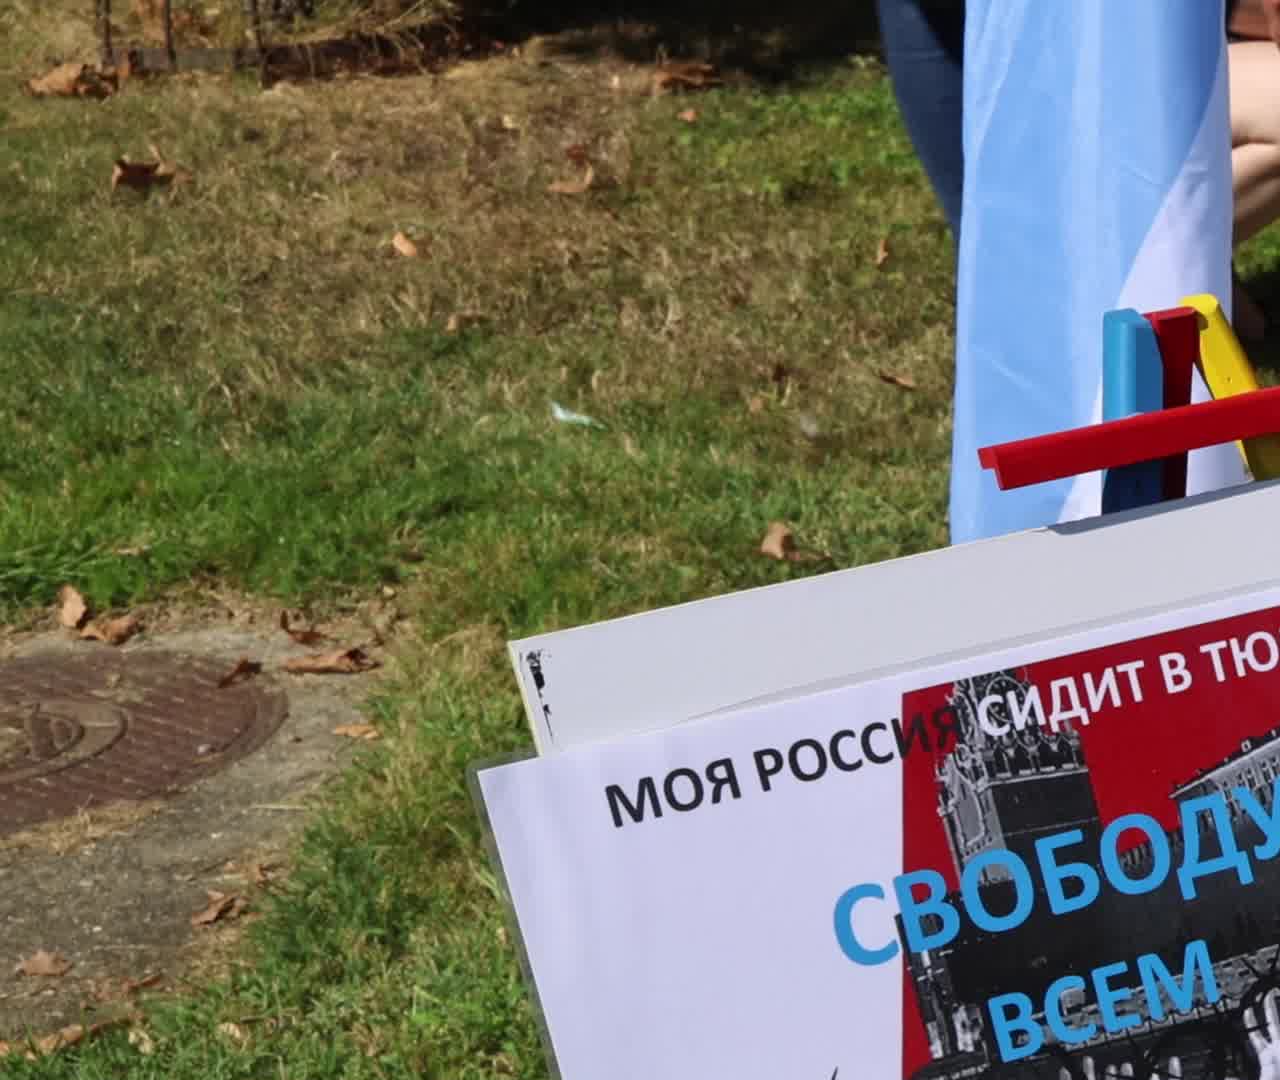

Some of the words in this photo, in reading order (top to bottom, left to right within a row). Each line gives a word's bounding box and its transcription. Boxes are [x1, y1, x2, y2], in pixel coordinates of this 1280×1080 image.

[605, 757, 741, 828] МОЯ
[753, 707, 963, 795] РОССИЯ
[977, 653, 1152, 741] СИДИТ
[1163, 645, 1193, 695] В
[988, 940, 1221, 1063] ВСЕМ
